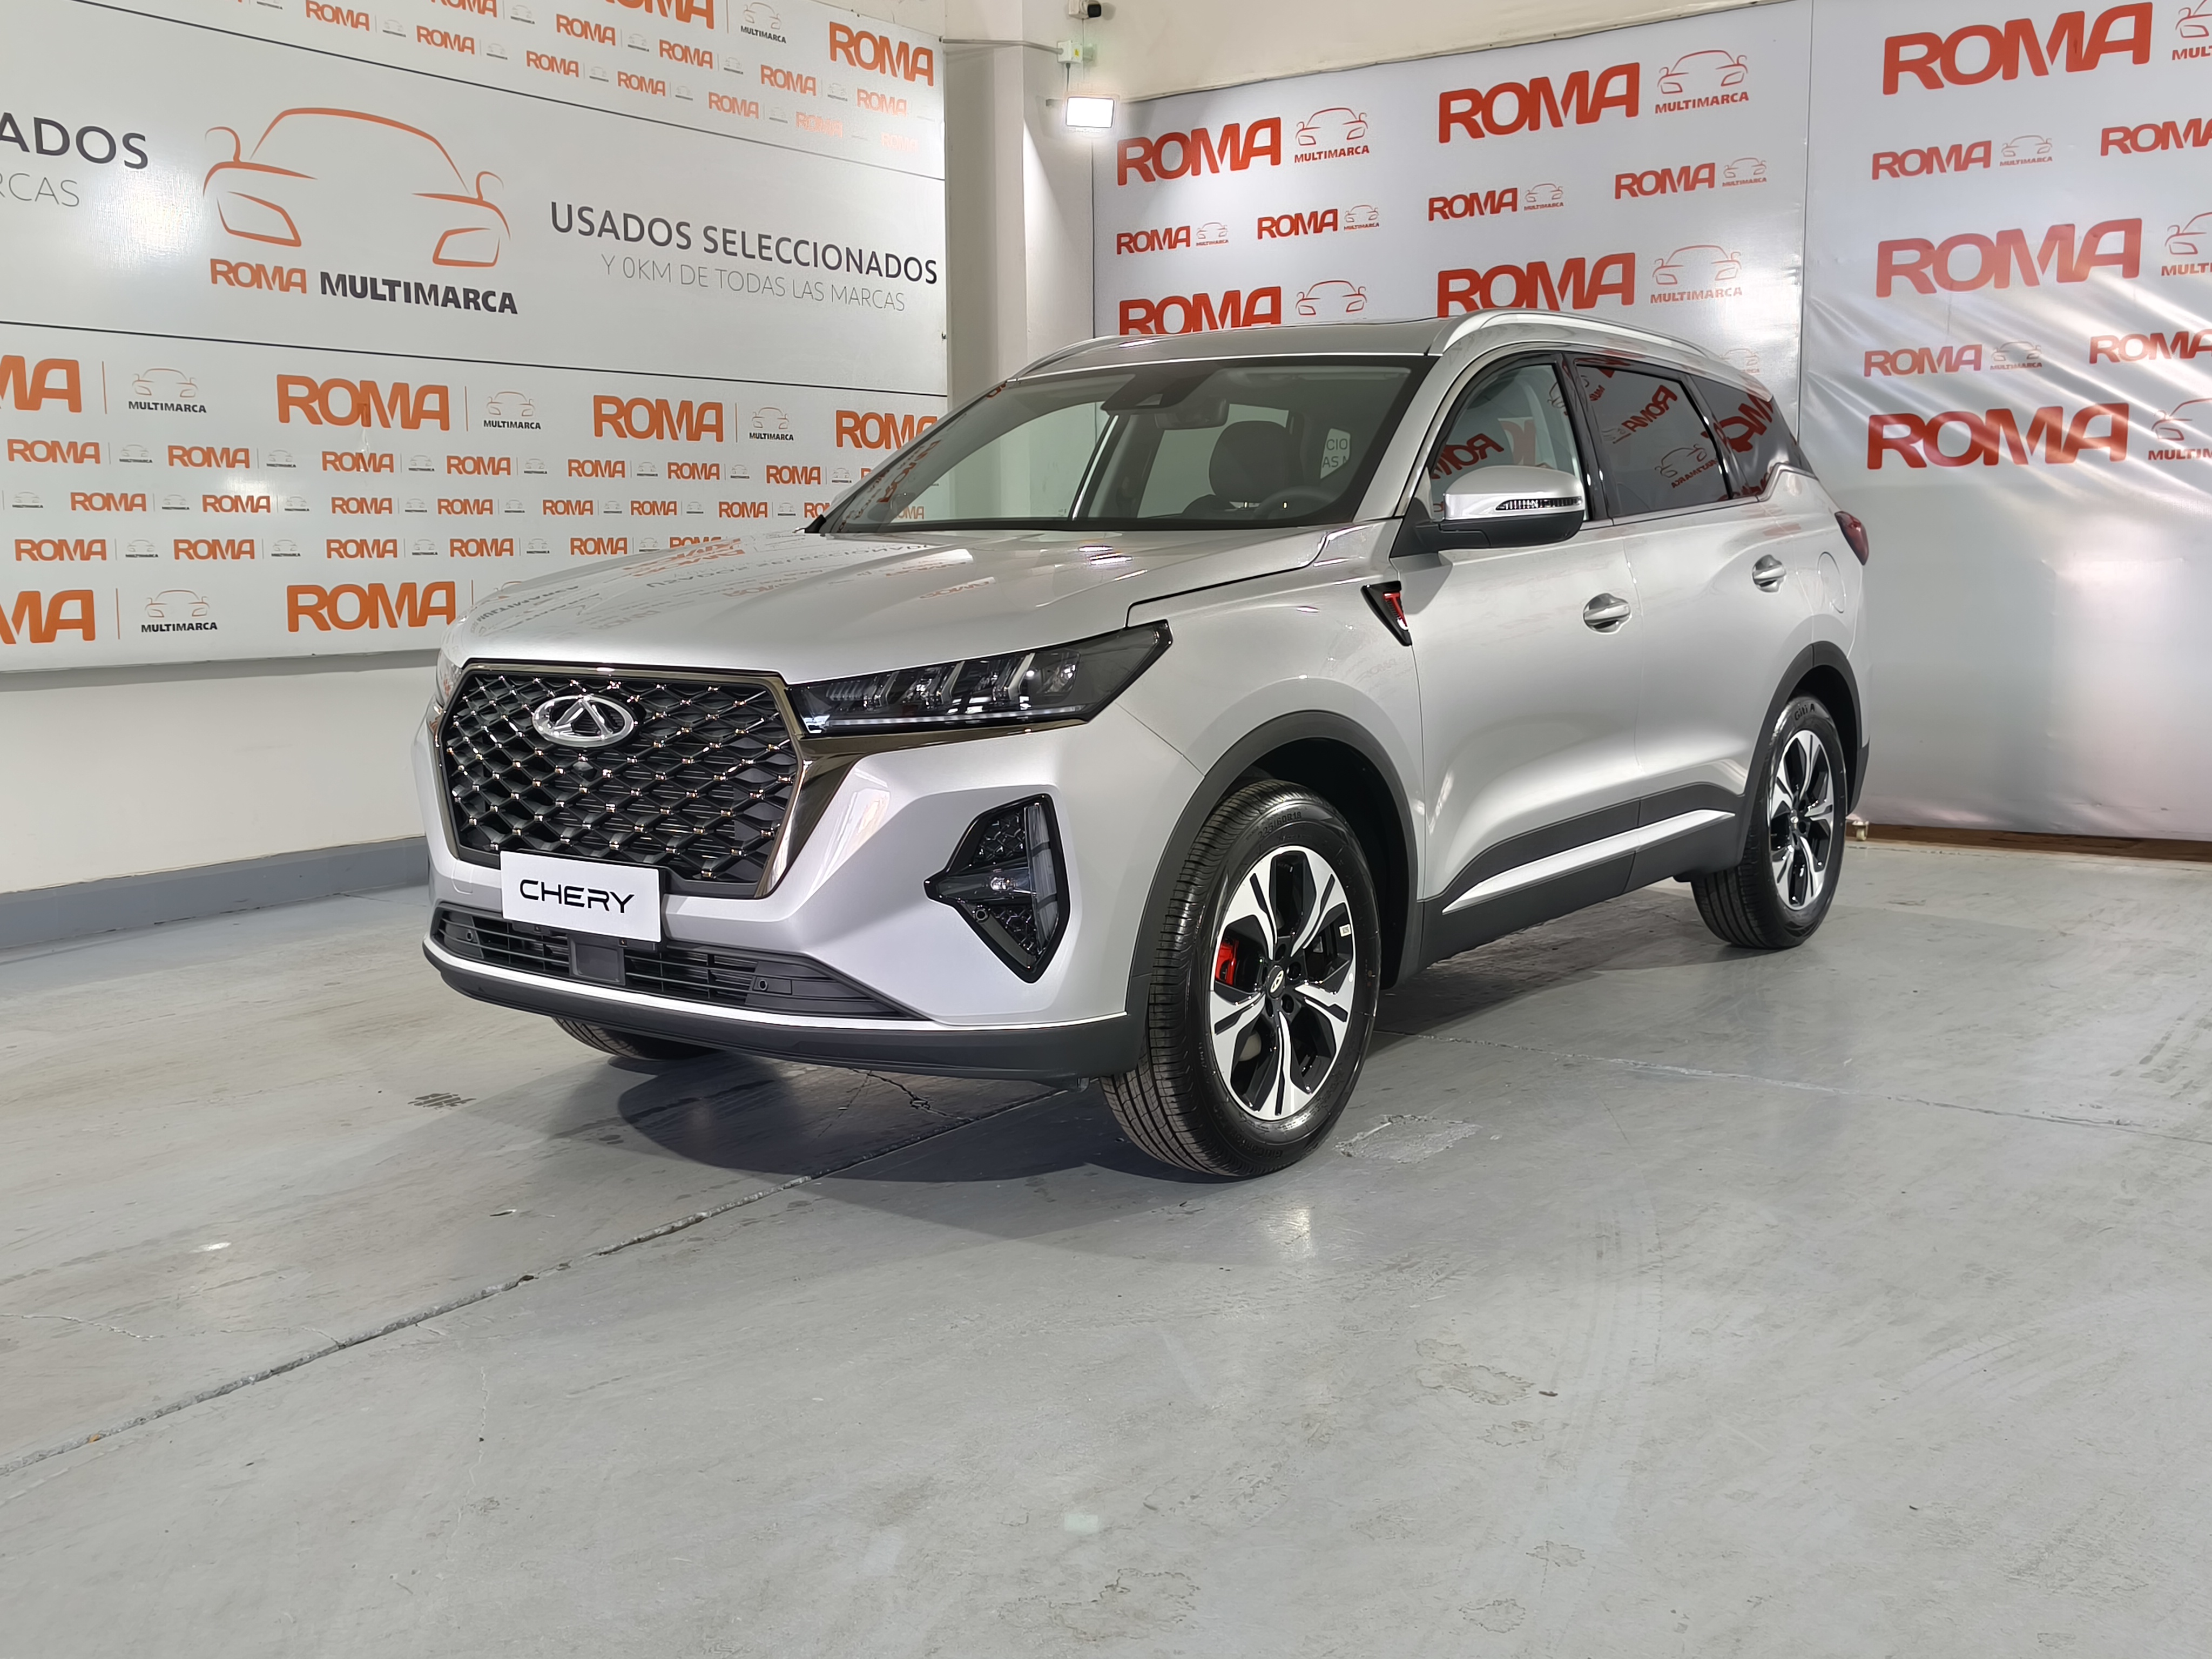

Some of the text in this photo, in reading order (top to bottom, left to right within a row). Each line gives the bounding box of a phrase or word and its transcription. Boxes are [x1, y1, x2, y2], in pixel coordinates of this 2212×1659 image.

[306, 0, 370, 31] ROMA
[416, 25, 475, 55] ROMA
[556, 14, 616, 46] ROMA
[741, 25, 786, 44] MULTIMARCA
[659, 39, 713, 70] ROMA
[829, 22, 934, 87] ROMA
[1883, 2, 2153, 96] ROMA
[526, 51, 579, 78] ROMA
[617, 71, 666, 97] ROMA
[761, 64, 817, 96] ROMA
[709, 92, 759, 119] ROMA
[857, 89, 907, 117] ROMA
[1439, 62, 1749, 144] ROMA MULTIMARCA
[1117, 117, 1370, 186] ROMA MULTIMARCA
[1872, 140, 1992, 180] ROMA
[1615, 163, 1716, 200] ROMA
[1428, 187, 1518, 222] ROMA
[1257, 208, 1339, 240] ROMA
[551, 201, 938, 285] USADOS SELECCIONADOS
[1116, 226, 1191, 255] ROMA
[1876, 218, 2143, 298] ROMA
[210, 259, 518, 315] ROMA MULTIMARCA
[601, 253, 615, 275] Y
[680, 264, 708, 287] DE
[714, 268, 786, 297] TODAS
[792, 279, 825, 301] LAS
[831, 284, 905, 312] MARCAS
[1437, 252, 1743, 319] ROMA MULTIMARCA
[1119, 286, 1282, 337] ROMA
[1864, 344, 1982, 377] ROMA
[129, 401, 207, 413] MULTIMARCA
[276, 374, 541, 431] ROMA MULTIMARCA
[593, 395, 794, 442] ROMA MULTIMARCA
[1867, 403, 2129, 470] ROMA
[7, 439, 100, 464] ROMA
[167, 445, 250, 469] ROMA
[322, 451, 394, 473] ROMA
[447, 455, 511, 476] ROMA
[568, 459, 626, 478] ROMA
[667, 462, 720, 481] ROMA
[766, 465, 821, 485] ROMA
[71, 492, 146, 512] ROMA
[202, 495, 271, 513] ROMA
[332, 497, 393, 515] ROMA
[437, 498, 494, 516] ROMA
[543, 500, 594, 516] ROMA
[631, 501, 678, 516] ROMA
[719, 502, 768, 519] ROMA
[15, 539, 107, 561] ROMA
[173, 539, 255, 561] ROMA
[326, 539, 398, 559] ROMA
[450, 538, 515, 558] ROMA
[570, 537, 628, 556] ROMA
[287, 581, 456, 633] ROMA
[141, 622, 218, 633] MULTIMARCA
[520, 879, 635, 913] CHERY
